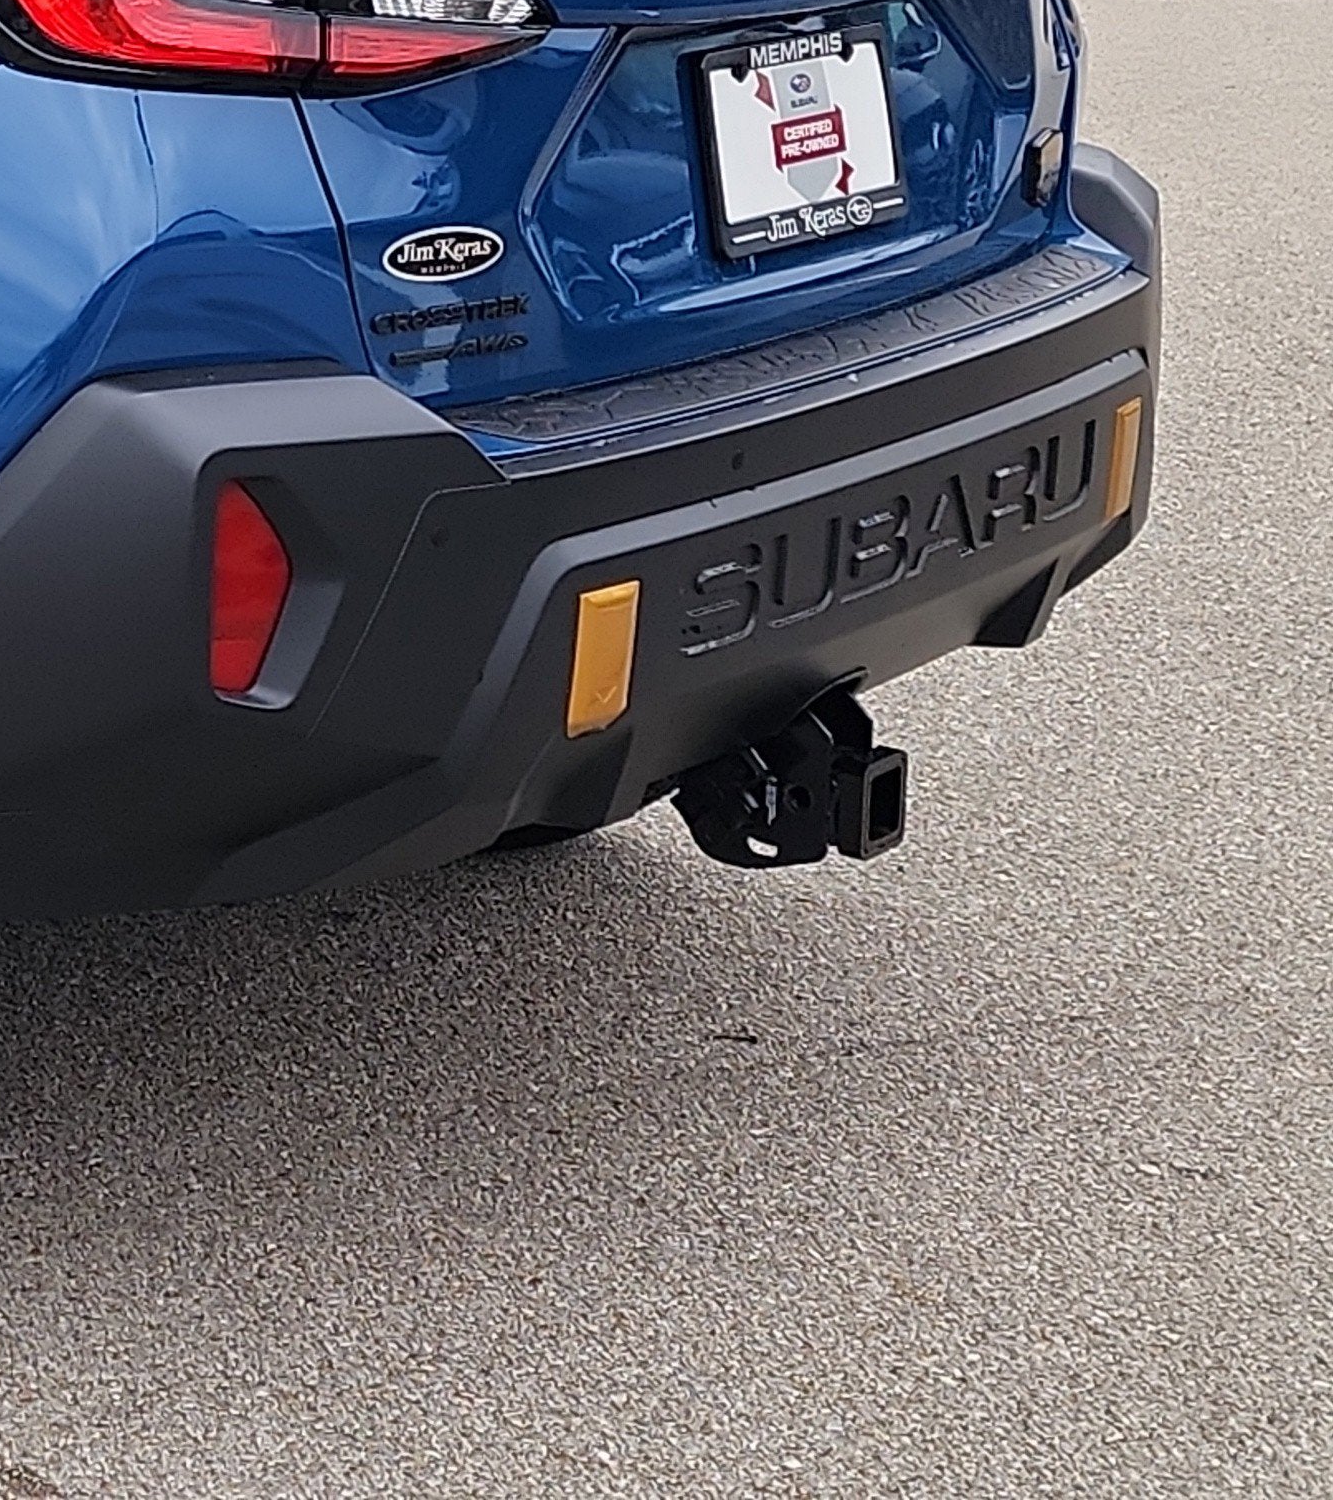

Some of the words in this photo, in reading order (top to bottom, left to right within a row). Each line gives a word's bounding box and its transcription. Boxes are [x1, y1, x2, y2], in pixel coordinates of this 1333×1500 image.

[749, 32, 843, 68] MEMPHIS
[784, 118, 833, 142] CERTIFIED
[766, 215, 799, 242] Jim
[799, 204, 847, 238] Keras
[397, 243, 434, 263] Jim
[434, 238, 493, 262] Keras
[370, 293, 530, 335] CROSSTREK
[679, 418, 1097, 657] SUBARU
